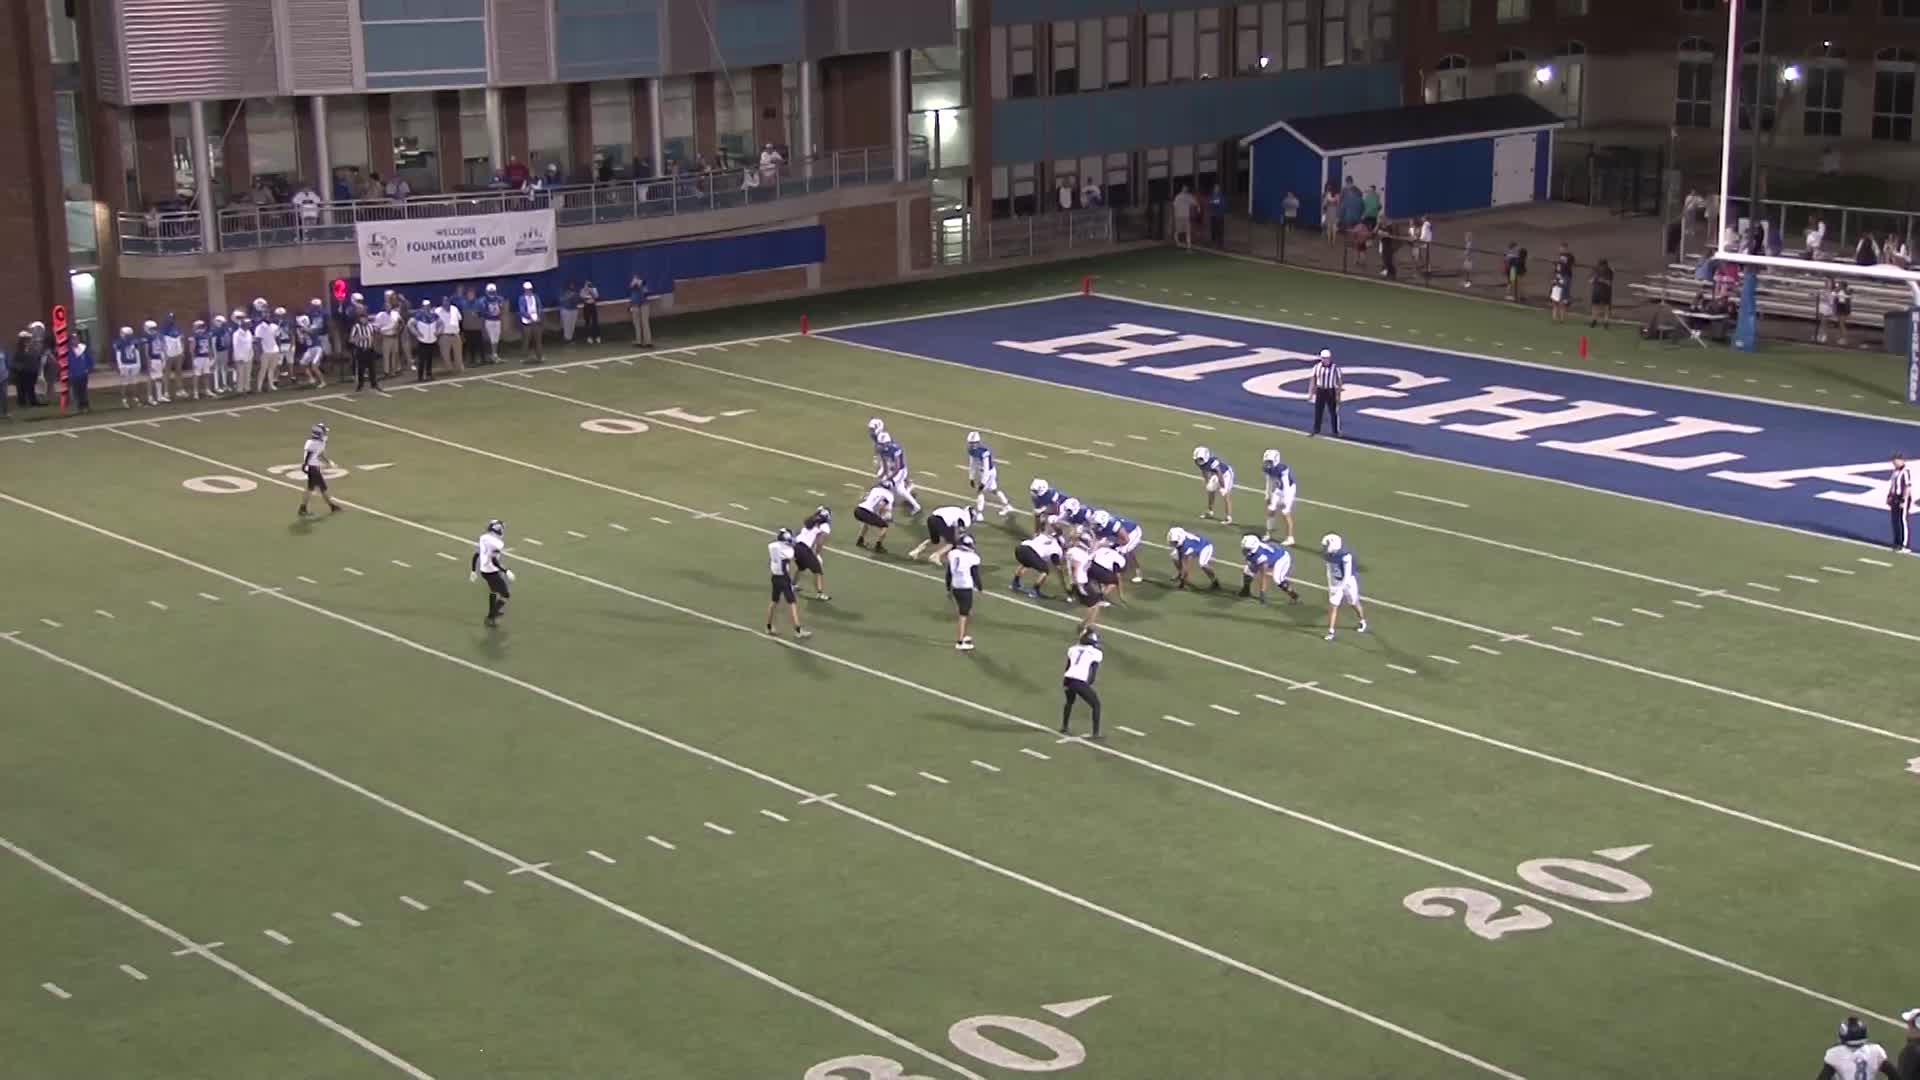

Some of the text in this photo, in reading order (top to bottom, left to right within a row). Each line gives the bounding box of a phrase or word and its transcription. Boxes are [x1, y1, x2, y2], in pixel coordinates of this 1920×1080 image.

[406, 237, 477, 253] FOUNDATION
[479, 235, 507, 249] CLUB
[431, 252, 485, 265] MEMBERS
